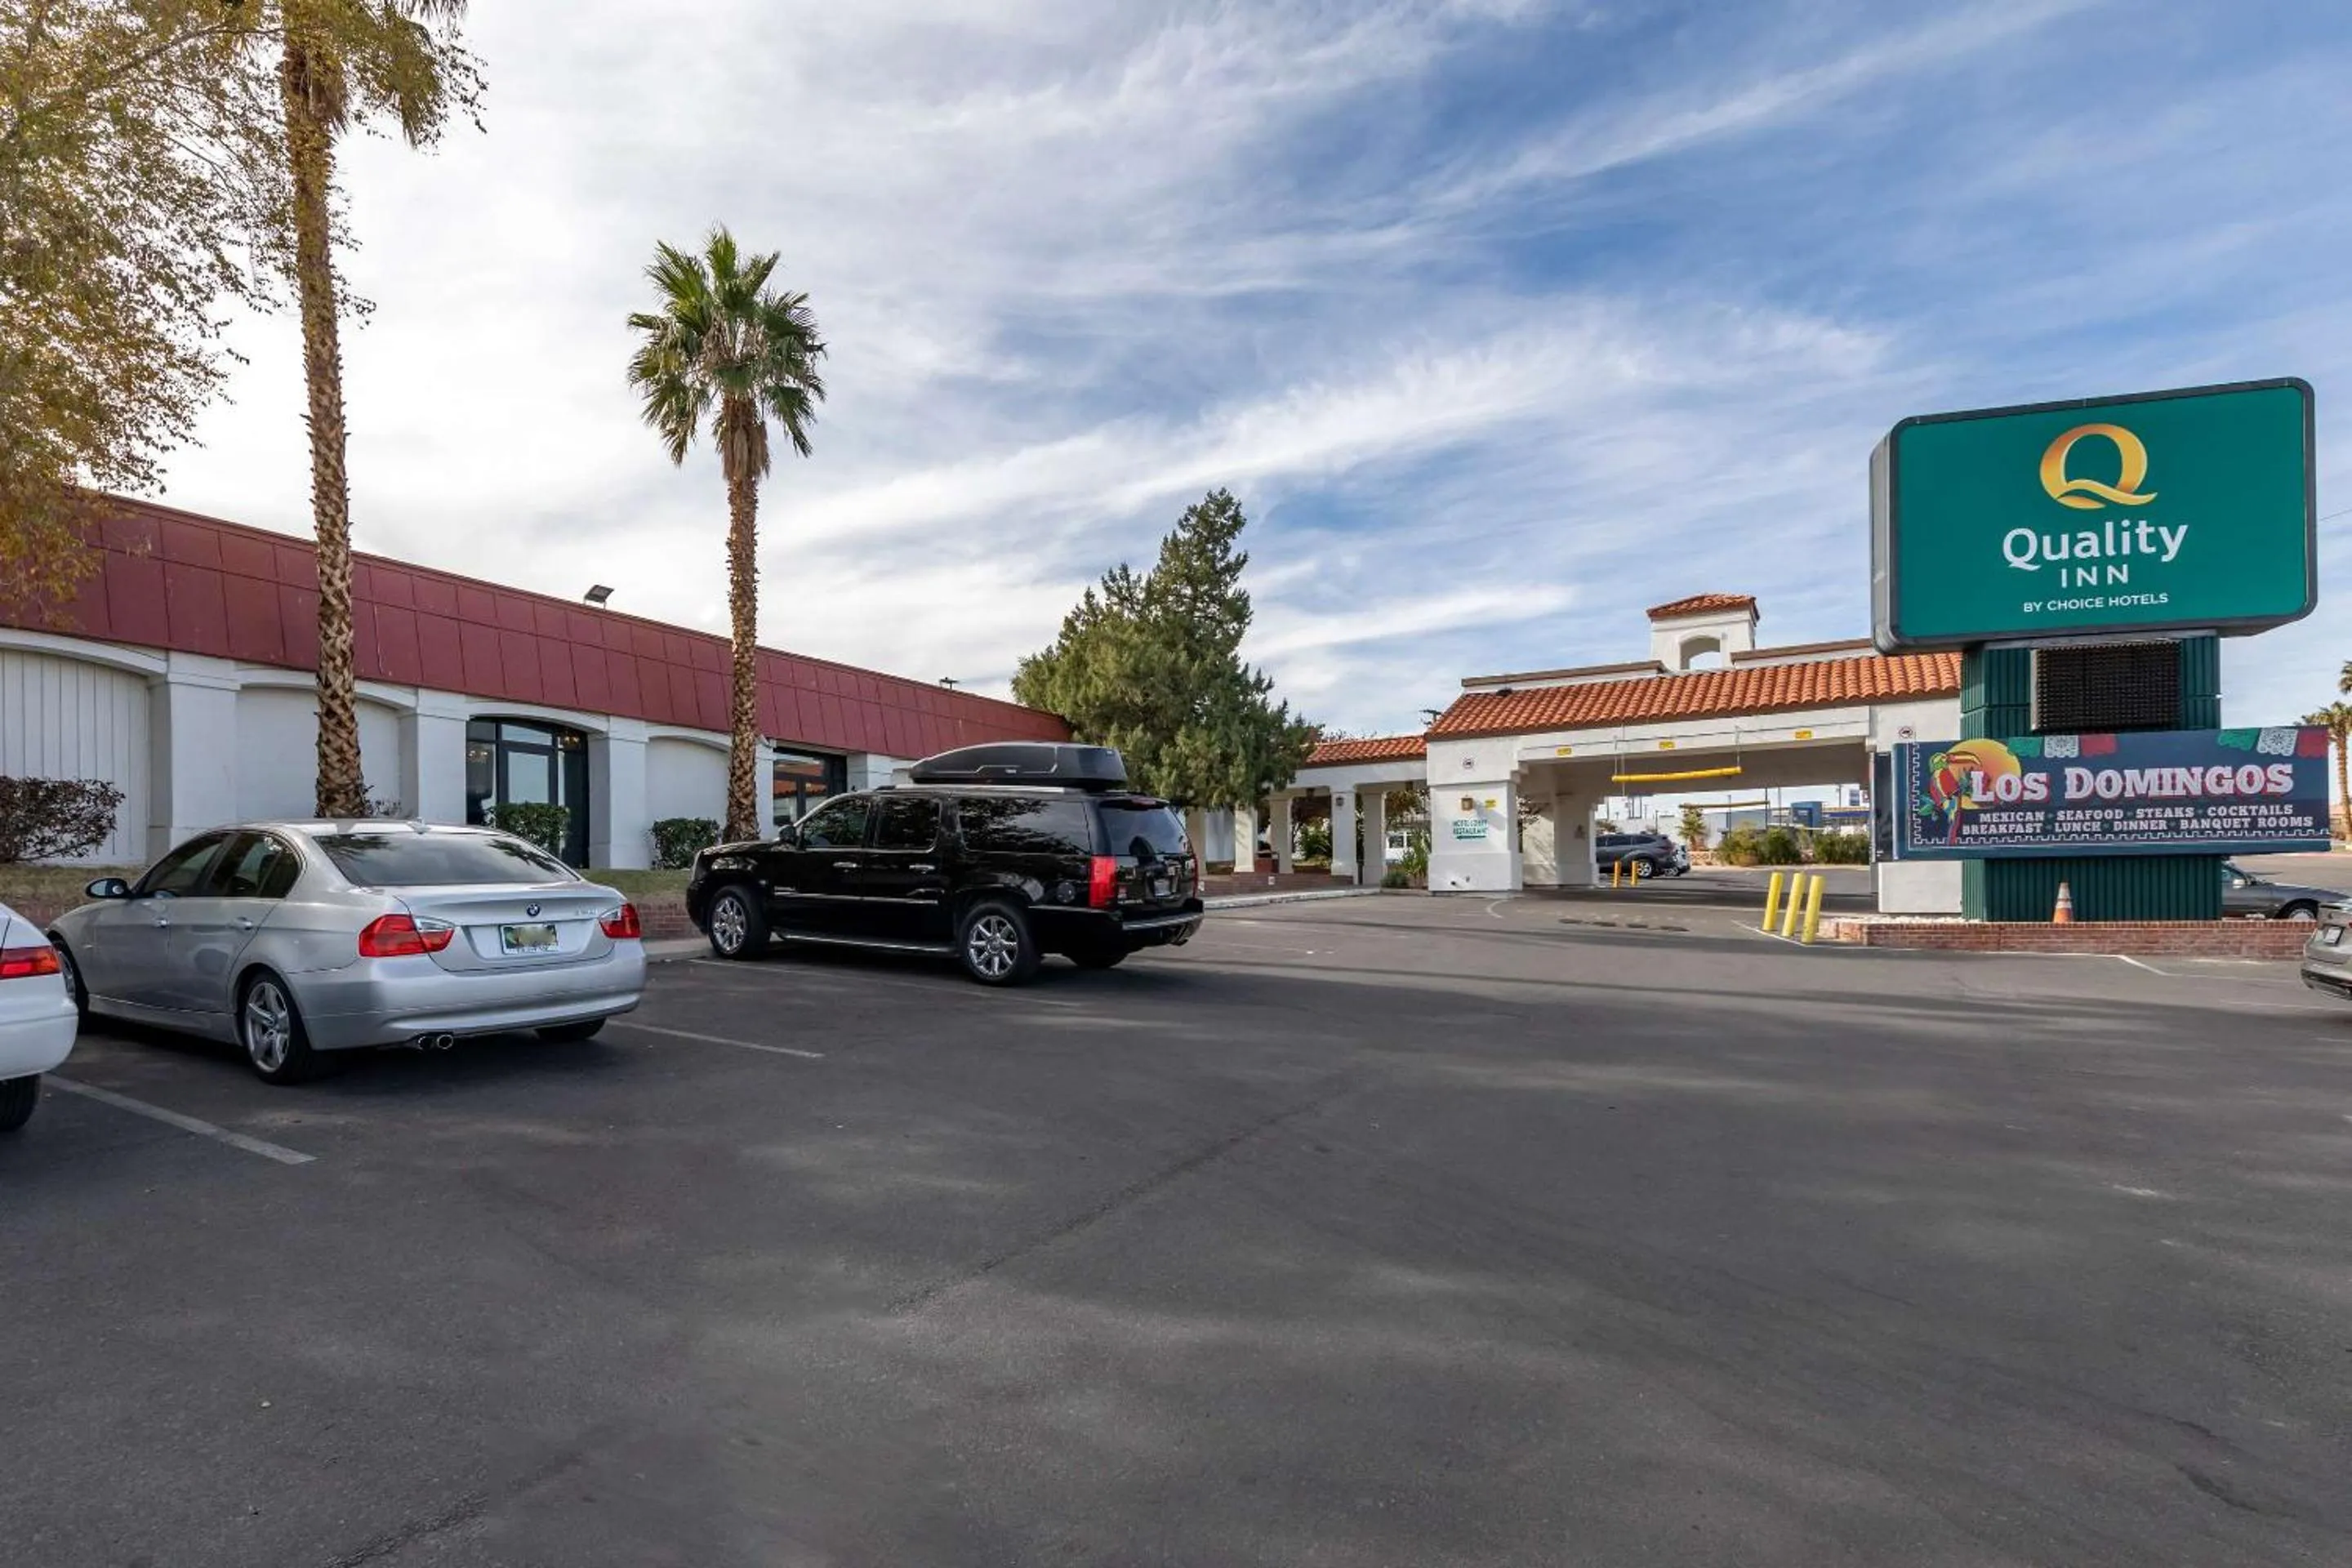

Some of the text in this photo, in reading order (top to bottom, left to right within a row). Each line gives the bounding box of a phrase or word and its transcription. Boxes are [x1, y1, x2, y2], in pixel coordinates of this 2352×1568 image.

[2039, 422, 2158, 510] Q
[2002, 519, 2189, 572] Quality
[2060, 564, 2129, 588] INN
[2023, 592, 2170, 612] BY CHOICE HOTELS
[1970, 762, 2294, 803] LOS DOMINGOS
[1979, 804, 2294, 822] MEXICAN SEAFOOD STEAKS COCKTAILS
[1962, 816, 2314, 835] BREAKFAST LUNCH DINNER BANQUET ROOMS
